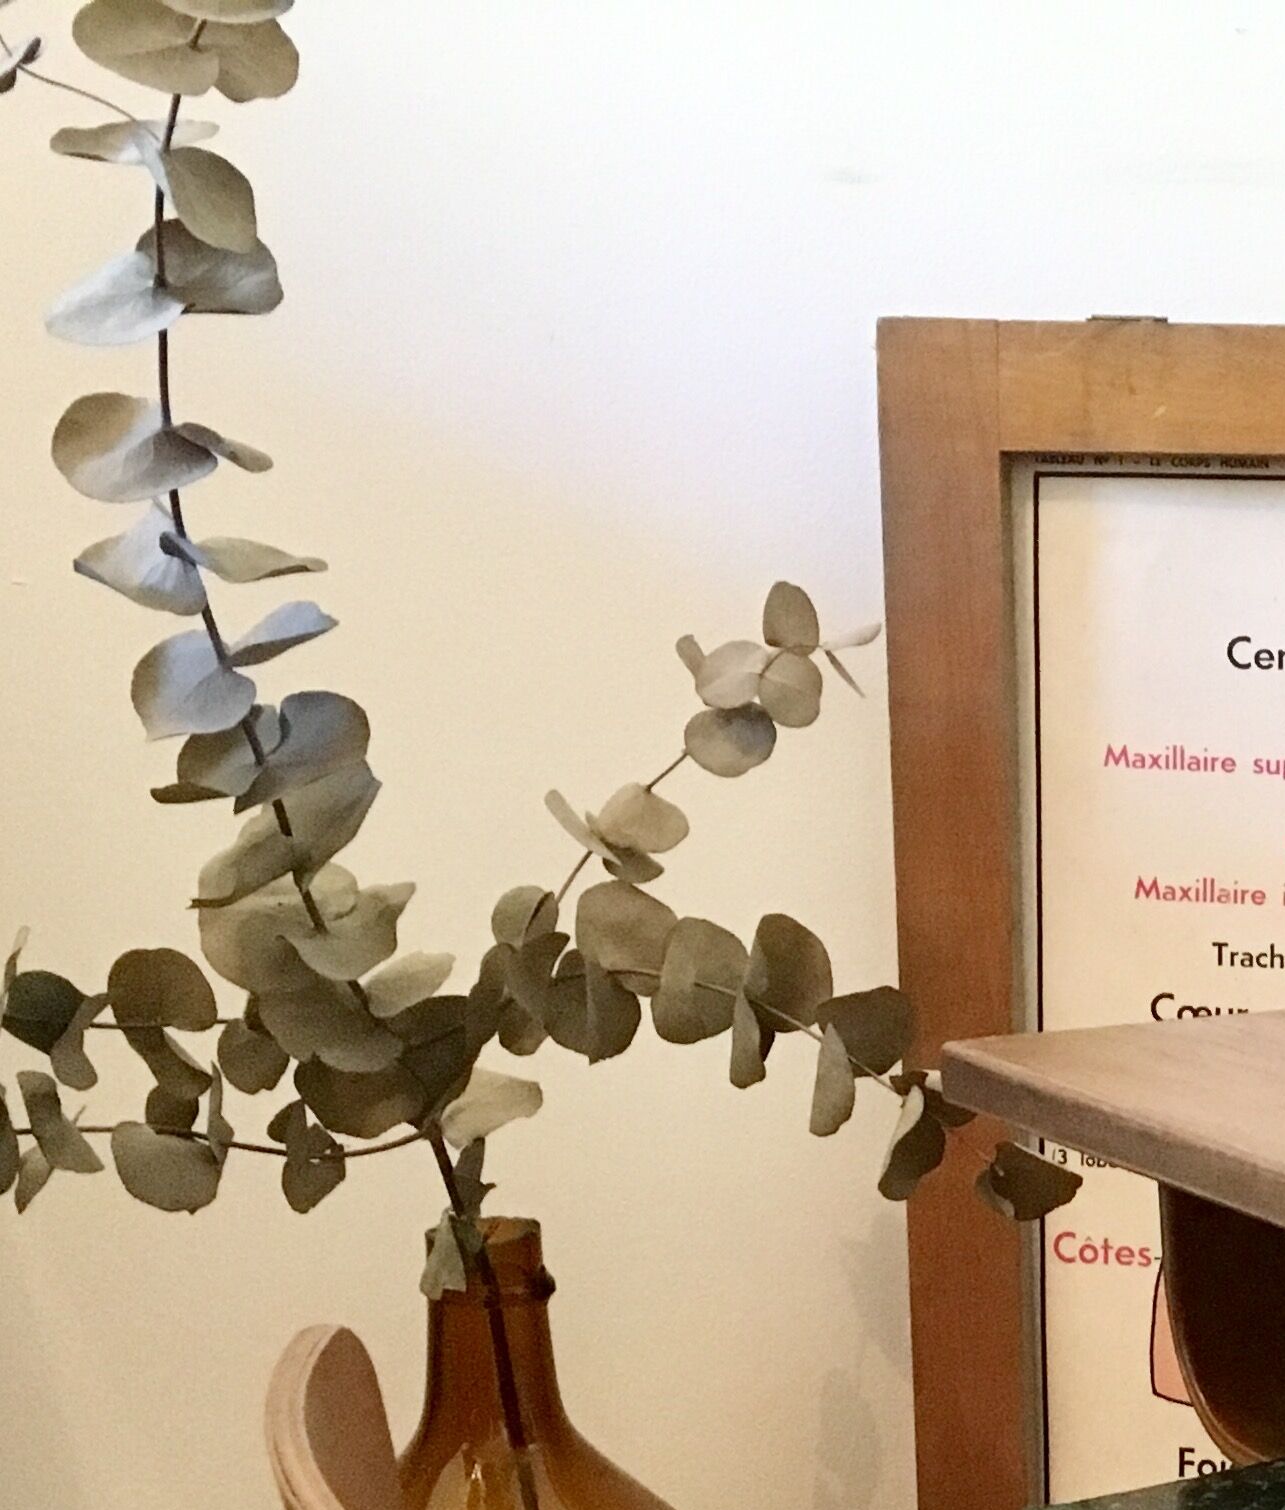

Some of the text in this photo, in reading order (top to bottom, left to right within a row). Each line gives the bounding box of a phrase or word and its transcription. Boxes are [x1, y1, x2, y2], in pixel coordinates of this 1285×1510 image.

[1103, 743, 1237, 774] Maxillaire
[1134, 875, 1267, 906] Maxillaire
[1052, 1231, 1152, 1268] Côtes
